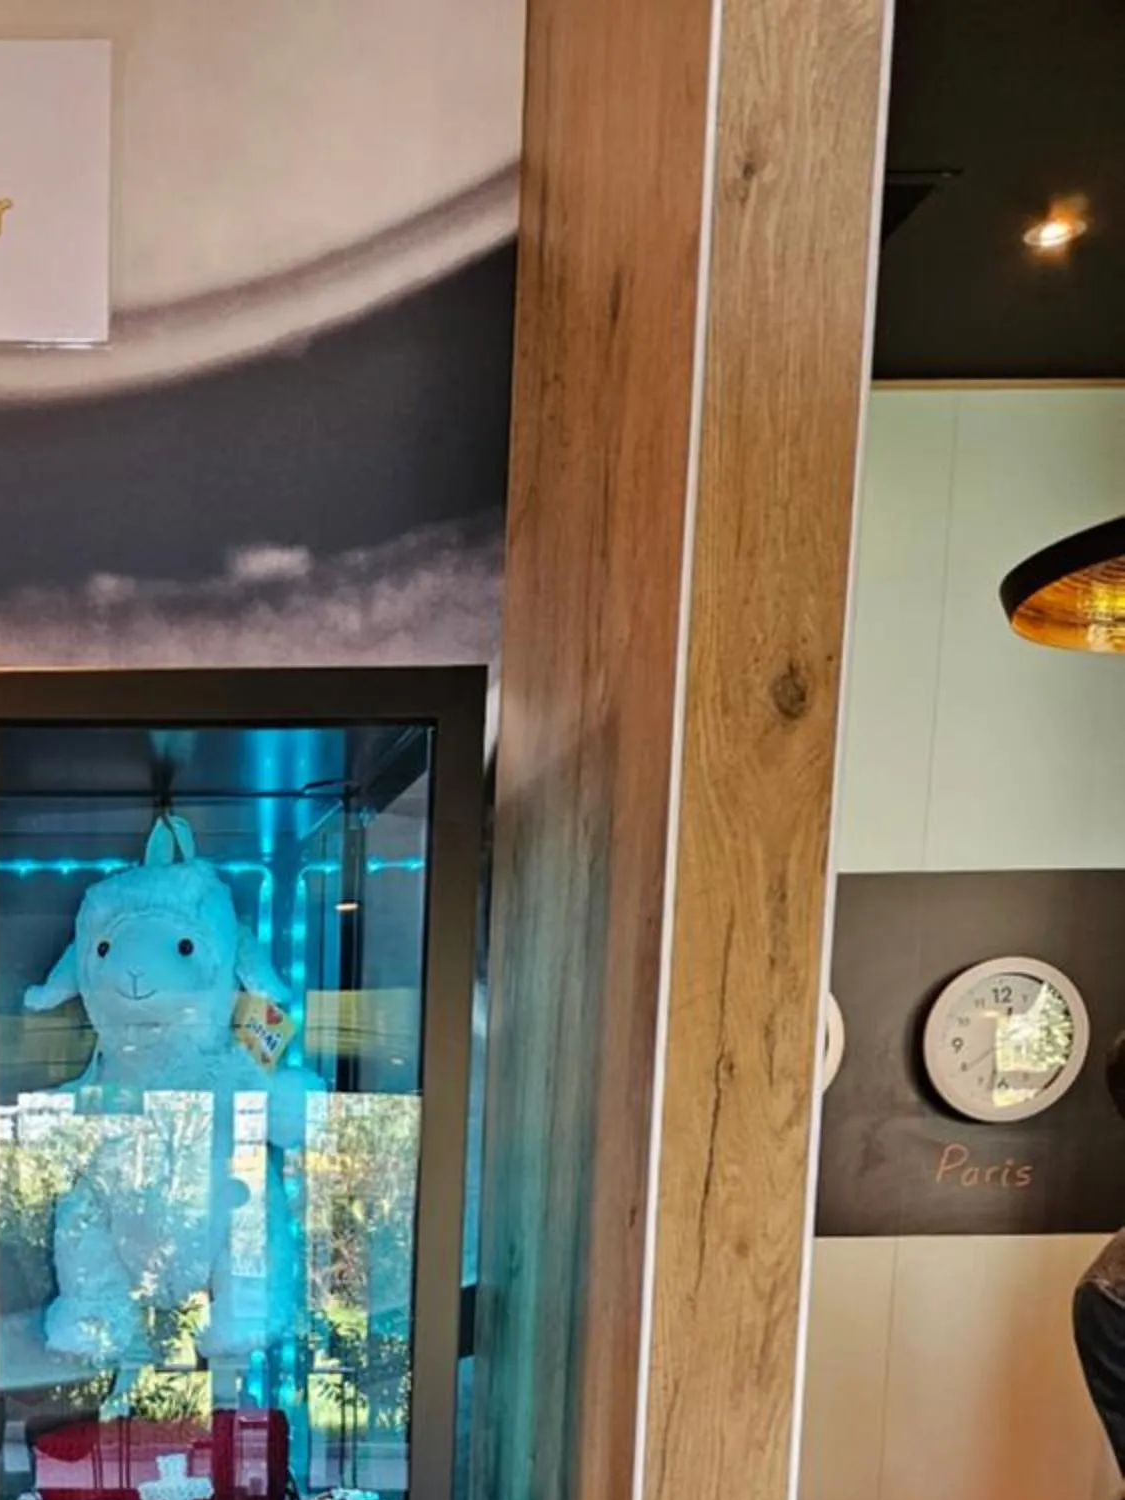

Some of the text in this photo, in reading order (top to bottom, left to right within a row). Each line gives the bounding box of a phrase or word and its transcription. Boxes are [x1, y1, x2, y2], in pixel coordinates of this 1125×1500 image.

[992, 986, 1013, 1004] 12
[951, 1037, 964, 1053] 9
[936, 1143, 1033, 1187] Paris
